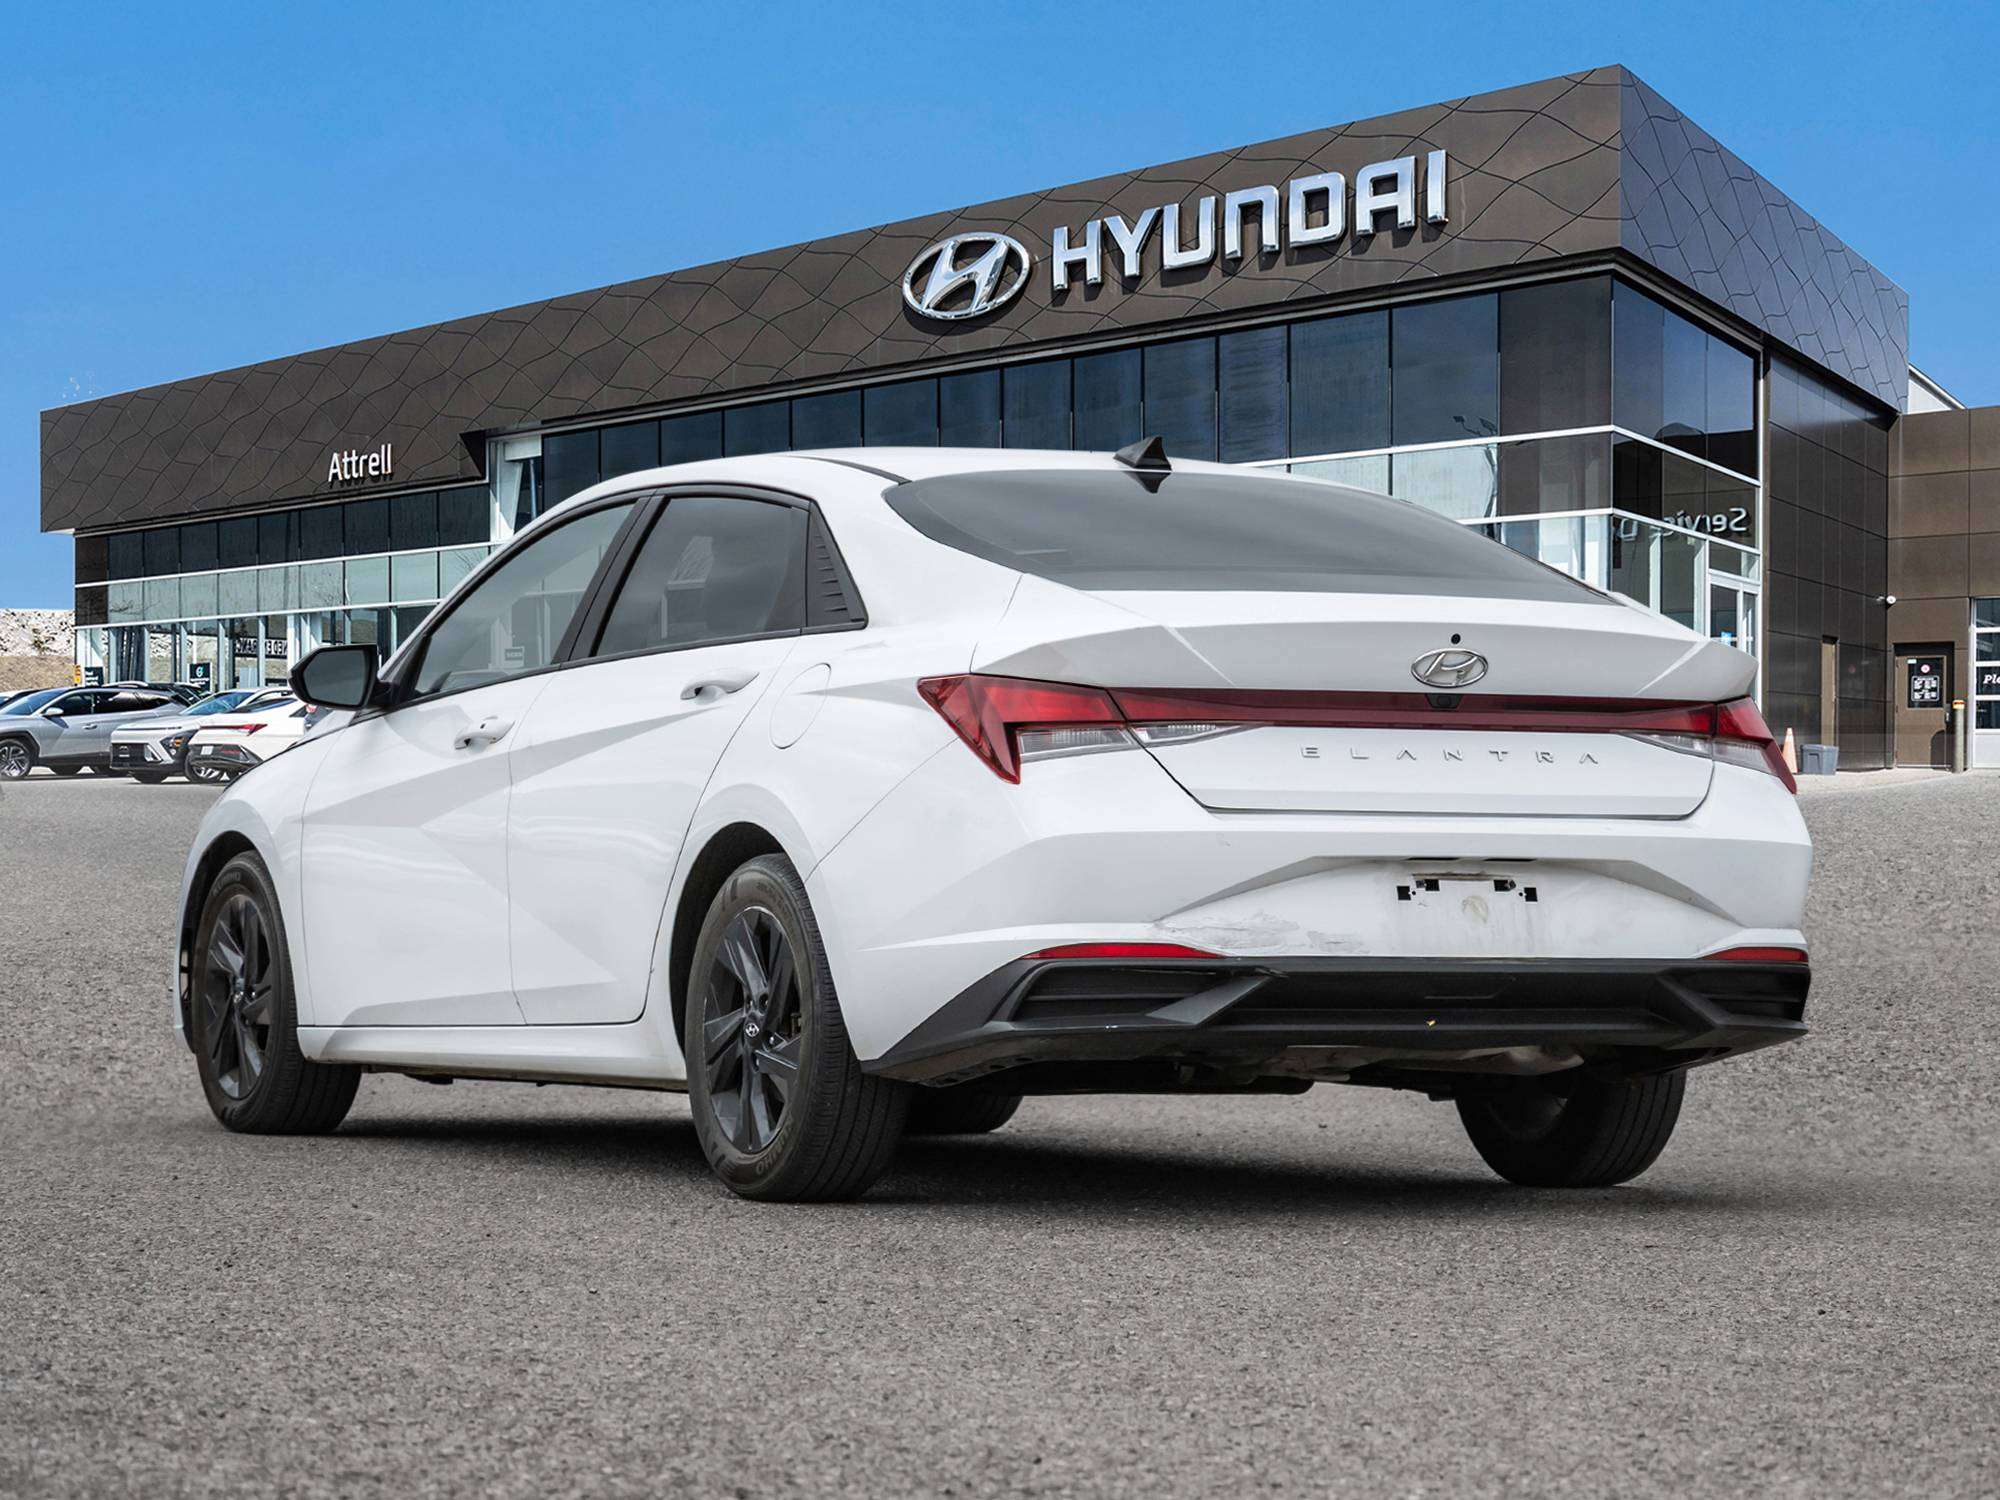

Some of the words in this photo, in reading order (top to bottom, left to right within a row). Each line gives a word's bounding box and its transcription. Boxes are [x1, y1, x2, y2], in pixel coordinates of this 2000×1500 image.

[1052, 149, 1448, 290] HYUNDAI
[328, 443, 392, 482] Attrell
[1301, 746, 1598, 765] ELANTRA
